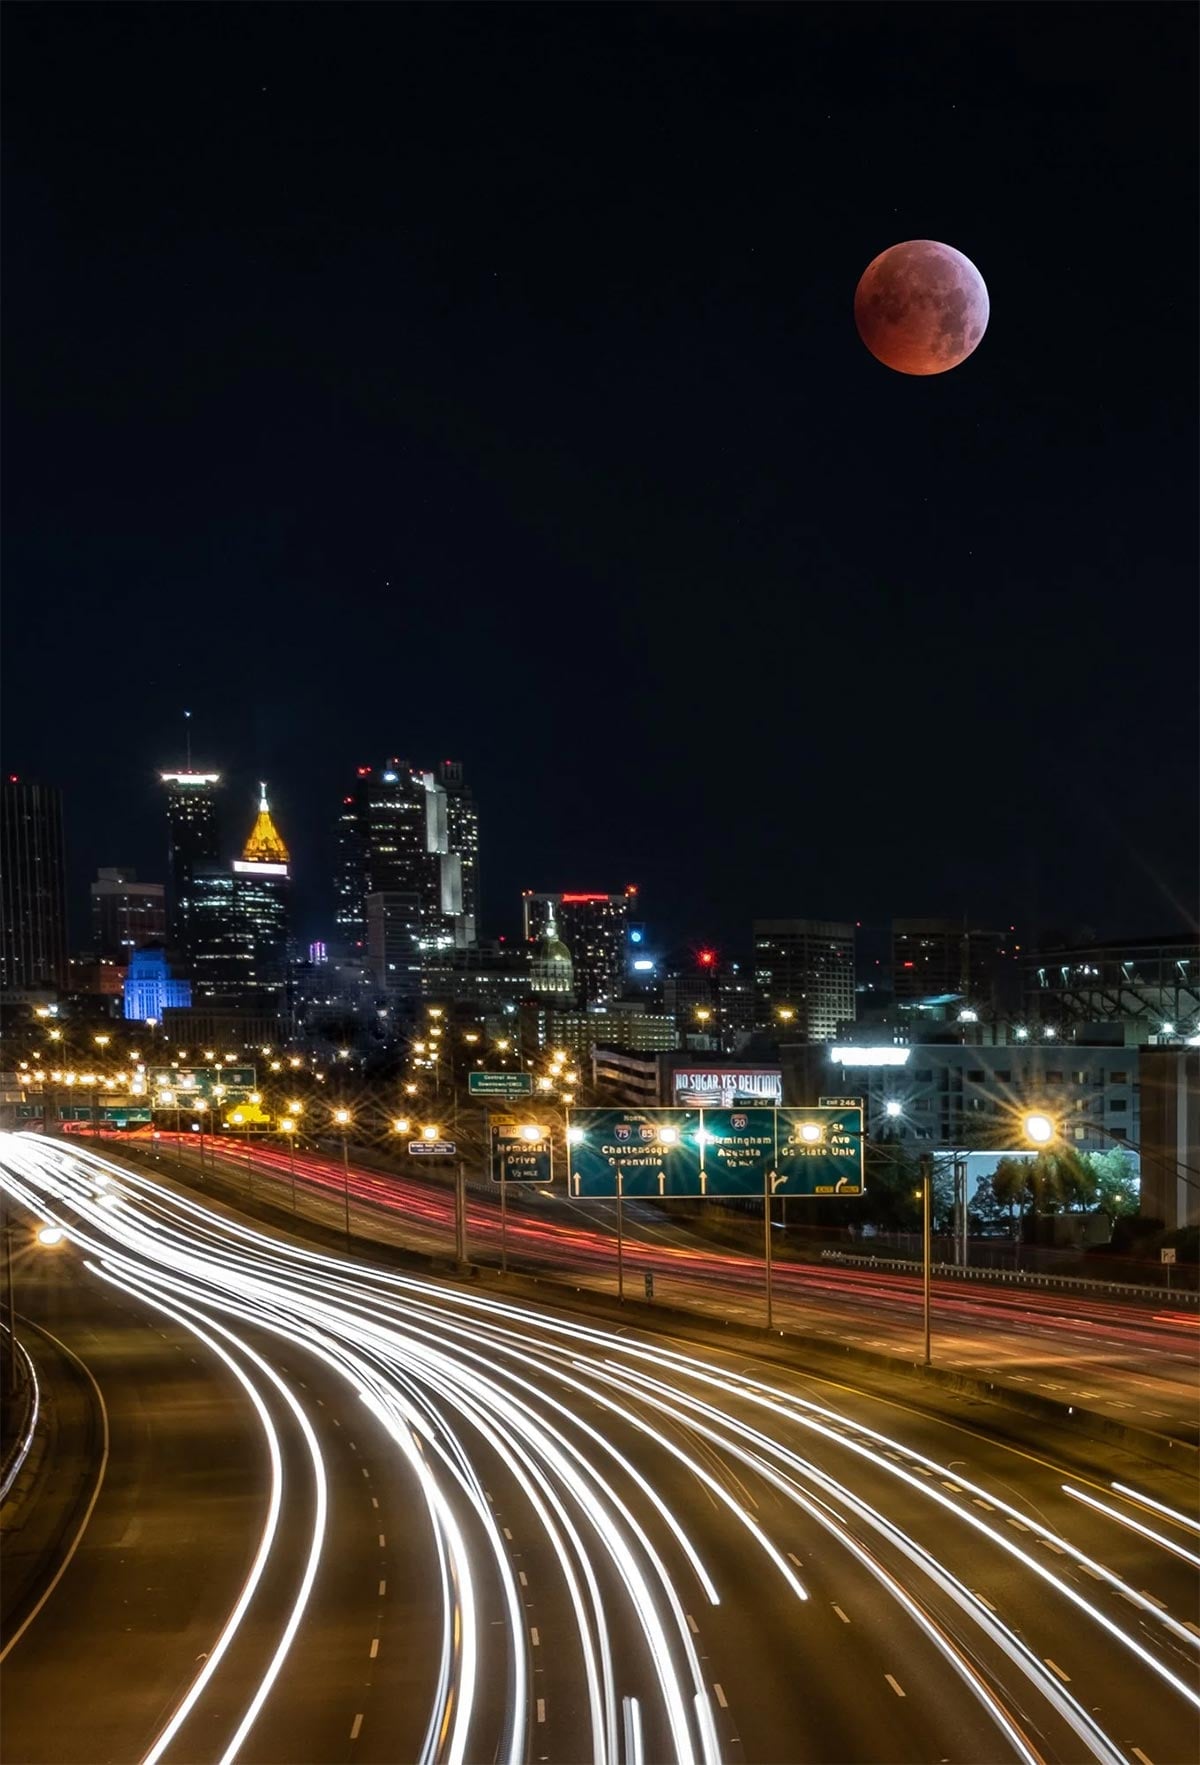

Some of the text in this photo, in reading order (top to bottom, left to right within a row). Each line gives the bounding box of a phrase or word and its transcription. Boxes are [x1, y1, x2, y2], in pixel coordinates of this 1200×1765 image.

[675, 1074, 688, 1090] NO
[721, 1074, 736, 1090] YES
[738, 1074, 782, 1097] DELICIOUS
[734, 1119, 746, 1128] 20
[618, 1128, 653, 1138] 75 85
[831, 1135, 850, 1144] Ave
[497, 1143, 547, 1152] Memorial
[601, 1145, 669, 1156] Chattanooga
[800, 1147, 827, 1156] State
[831, 1147, 856, 1156] Univ
[717, 1148, 761, 1157] Augusta
[507, 1155, 537, 1164] Drive
